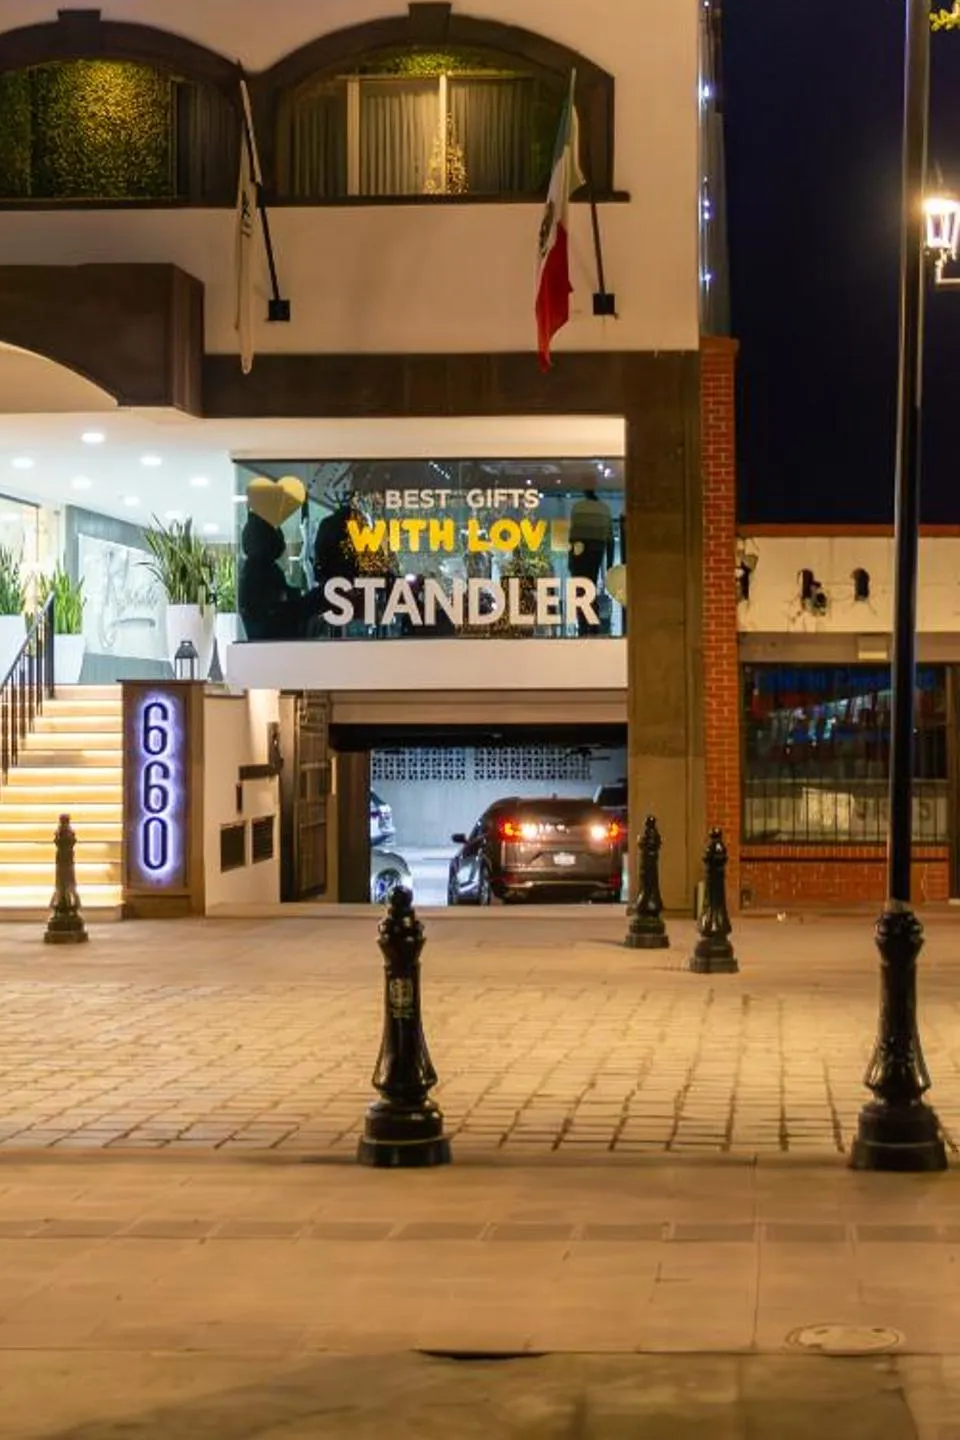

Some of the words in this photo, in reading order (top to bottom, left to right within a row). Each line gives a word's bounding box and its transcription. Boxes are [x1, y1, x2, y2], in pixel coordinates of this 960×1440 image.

[384, 488, 451, 510] BEST
[465, 488, 540, 510] GIFTS
[346, 518, 455, 553] WITH
[322, 575, 601, 627] STANDLER
[142, 701, 169, 871] 660
